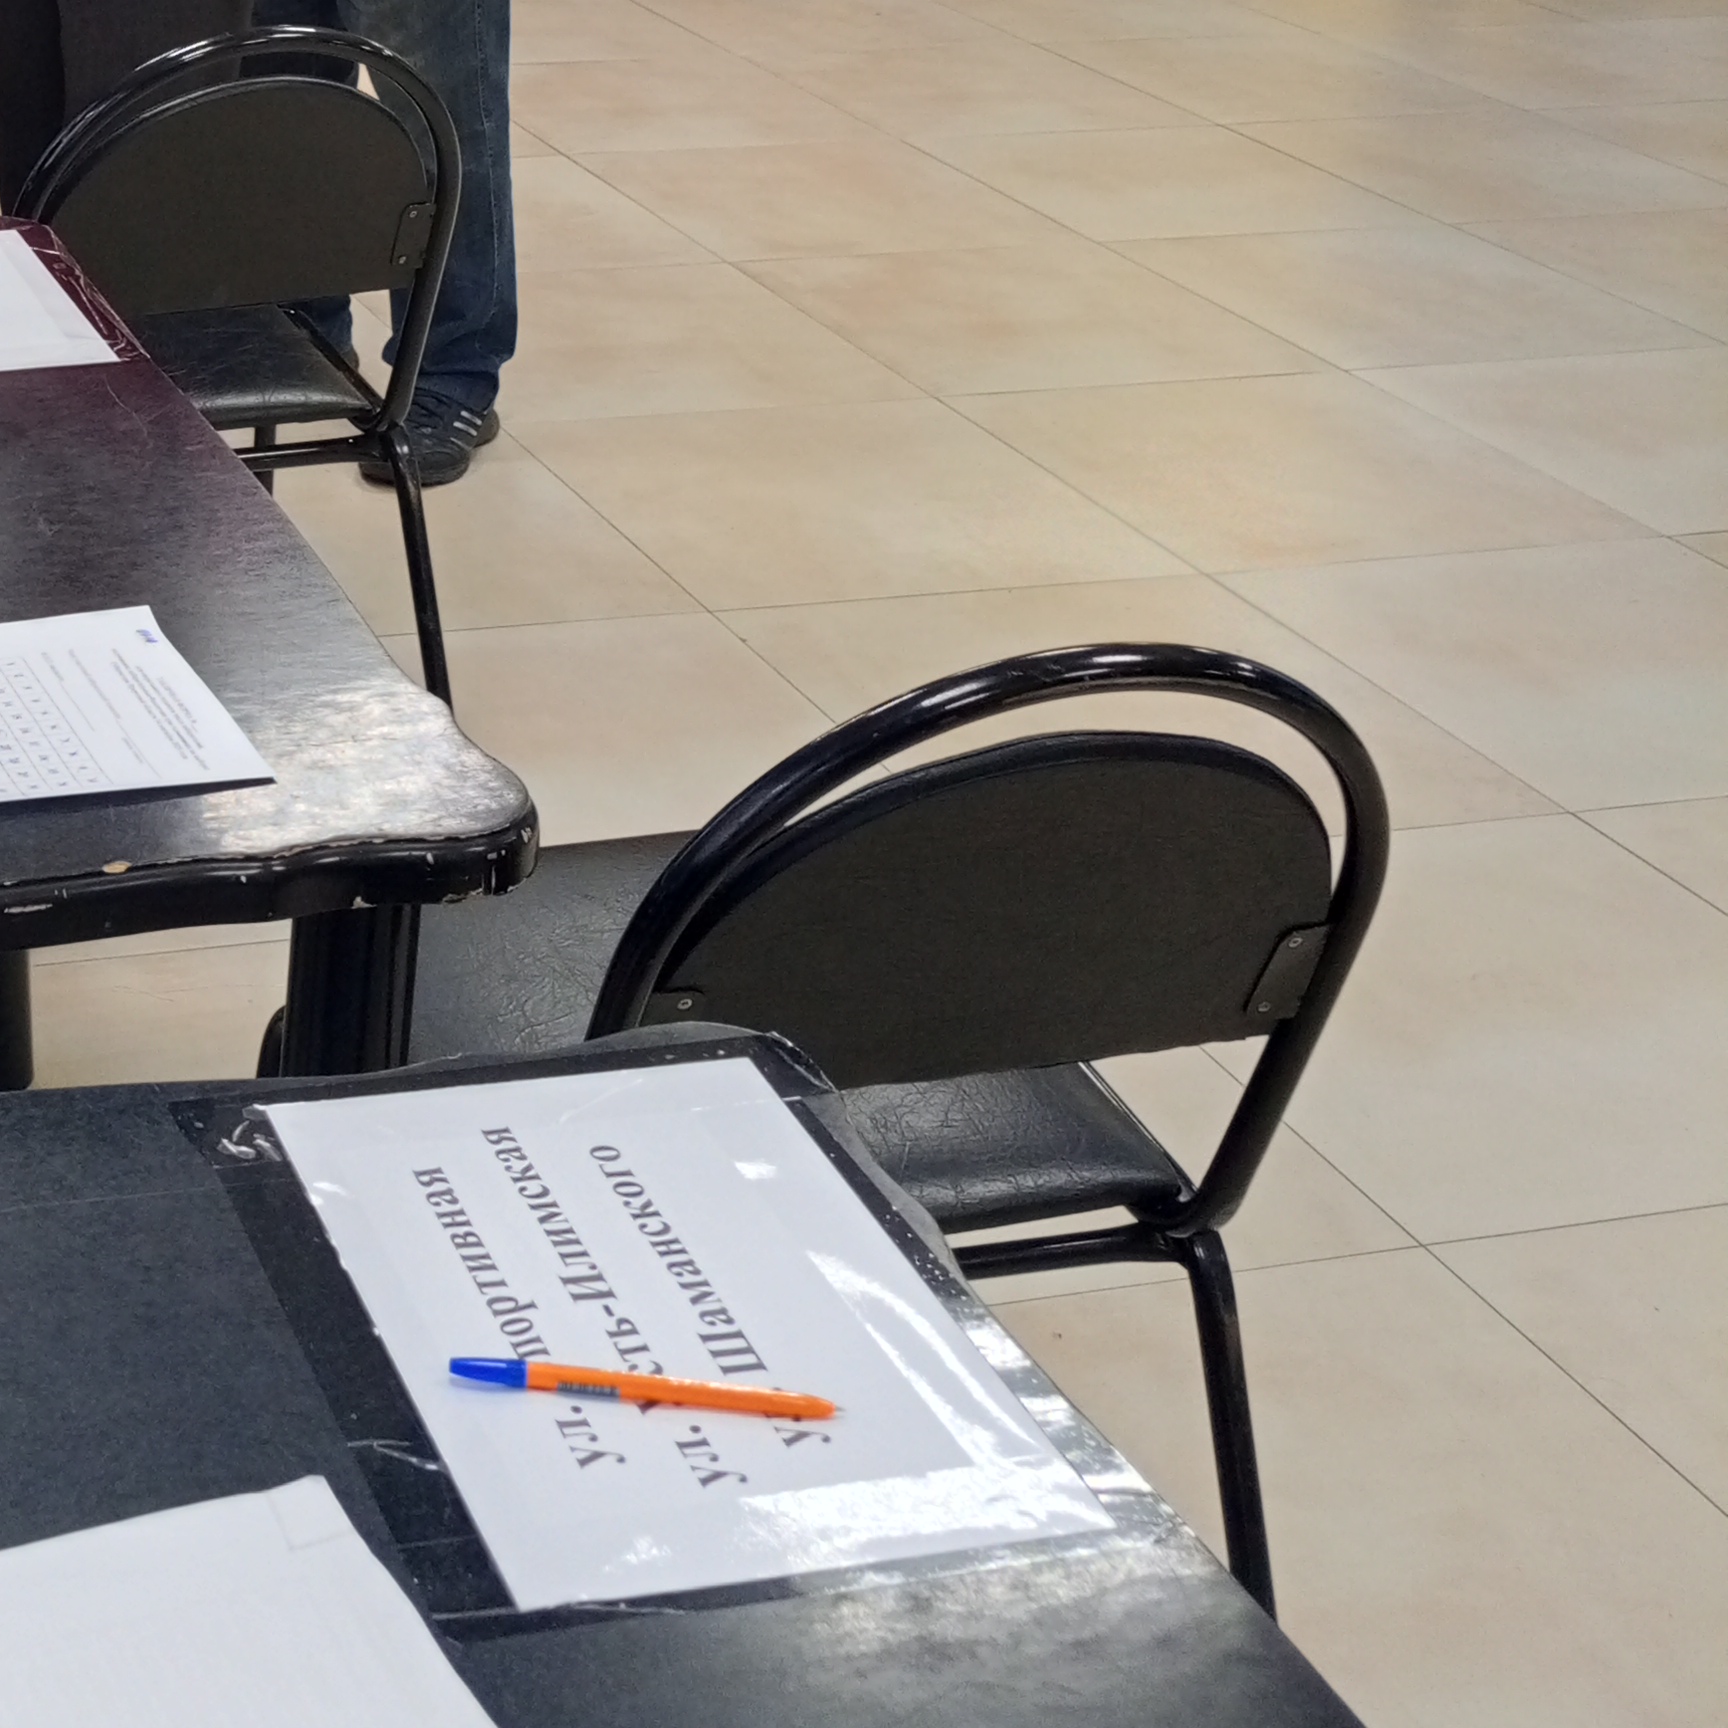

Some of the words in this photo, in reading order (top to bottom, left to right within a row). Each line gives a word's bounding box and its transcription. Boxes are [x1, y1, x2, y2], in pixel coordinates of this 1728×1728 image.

[412, 1166, 552, 1362] портивная
[588, 1144, 769, 1376] Шаманского
[555, 1404, 627, 1470] ул.
[674, 1424, 749, 1489] ул.
